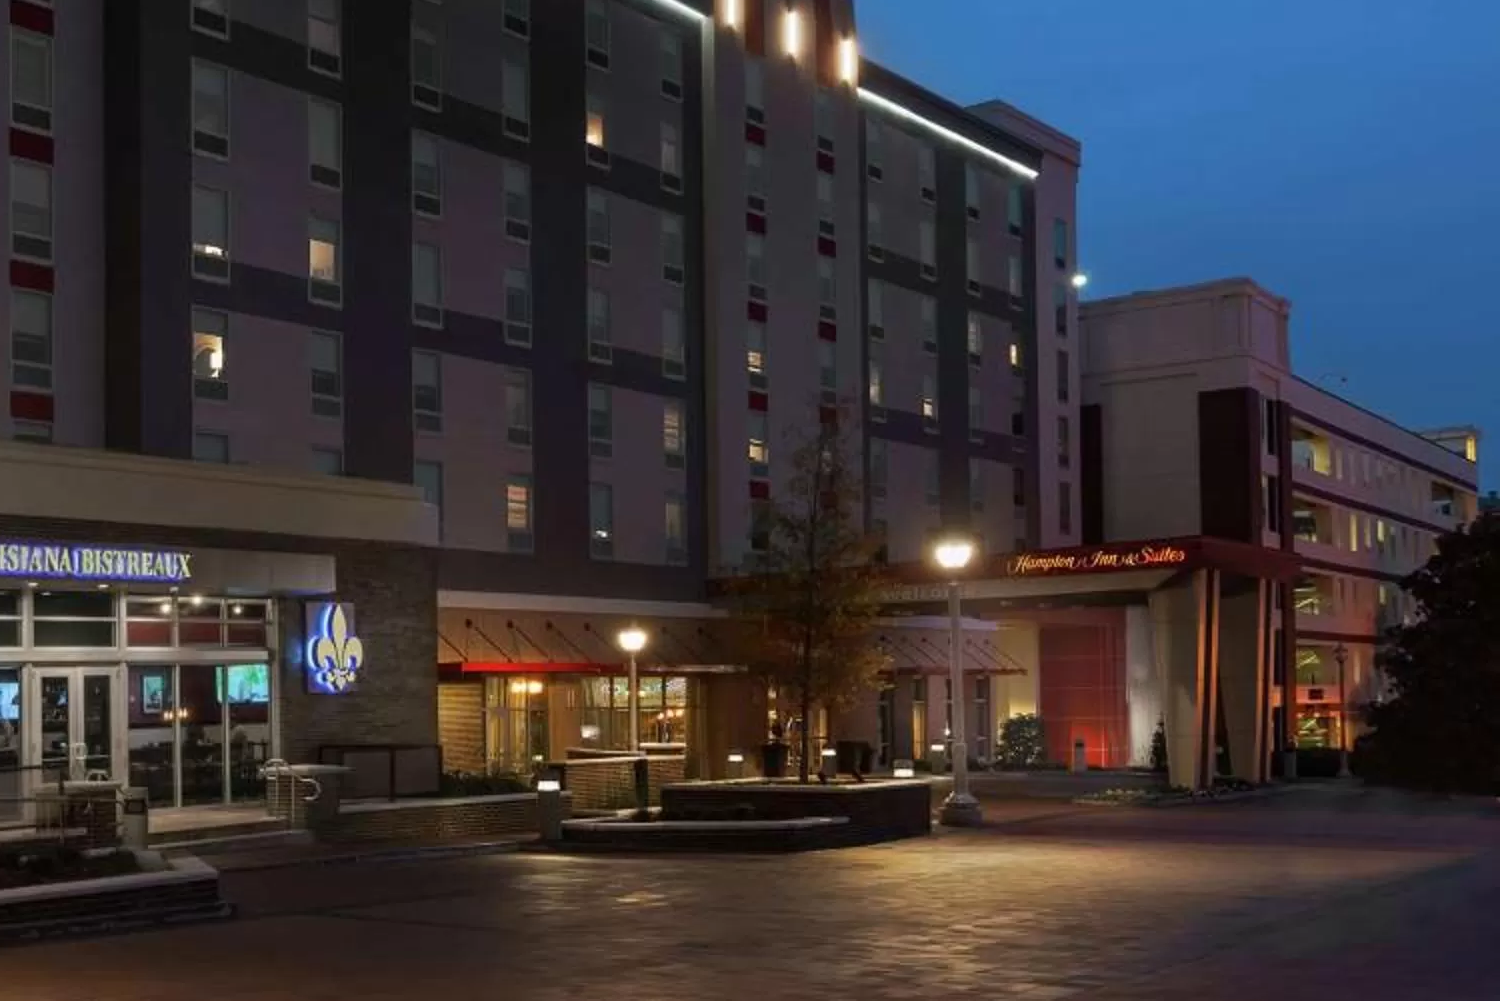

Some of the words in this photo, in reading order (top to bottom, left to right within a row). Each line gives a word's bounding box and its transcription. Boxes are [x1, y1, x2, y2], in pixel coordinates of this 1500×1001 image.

[81, 548, 193, 579] BISTREAUX
[1008, 553, 1080, 575] Hampton
[1081, 550, 1125, 569] Inn
[1137, 546, 1185, 565] Suites
